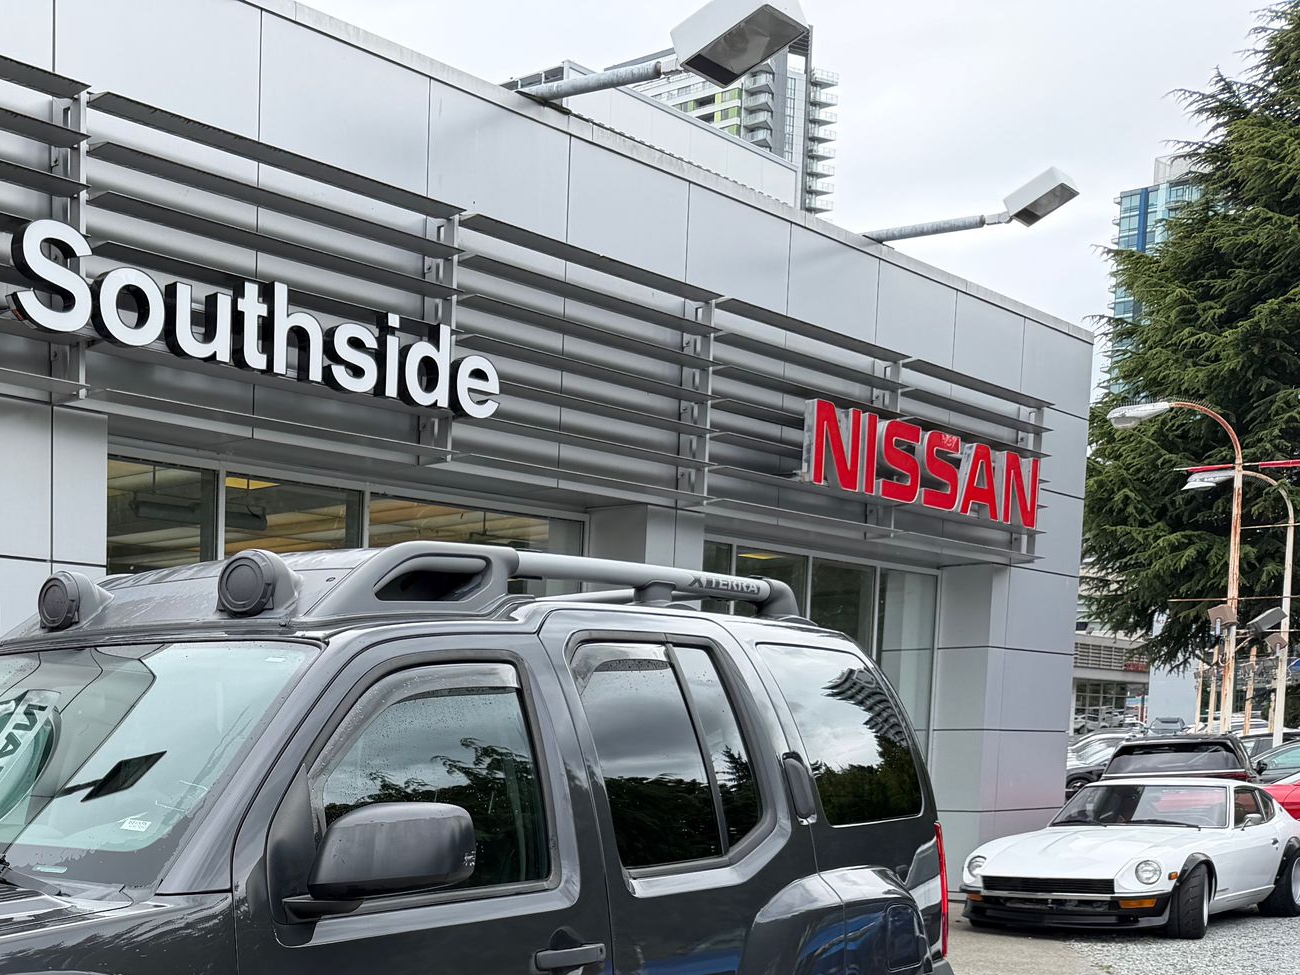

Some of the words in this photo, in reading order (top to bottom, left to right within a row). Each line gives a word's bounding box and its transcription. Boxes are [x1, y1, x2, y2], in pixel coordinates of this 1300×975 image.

[12, 218, 501, 420] Southside
[807, 398, 1040, 530] NISSAN
[688, 575, 761, 595] XTERRA
